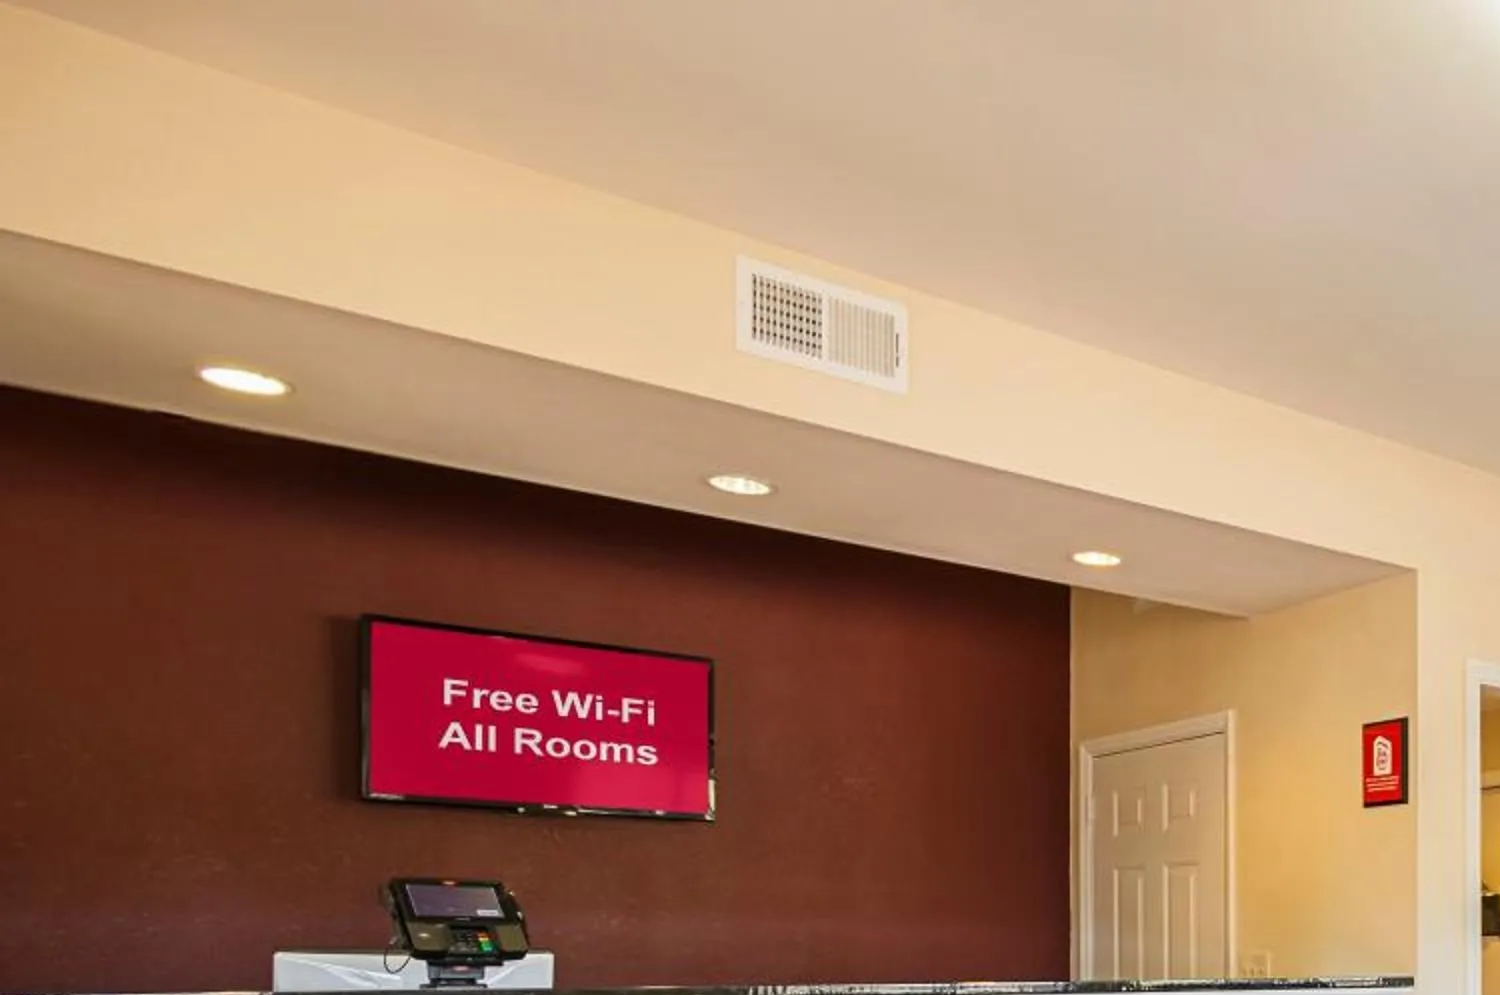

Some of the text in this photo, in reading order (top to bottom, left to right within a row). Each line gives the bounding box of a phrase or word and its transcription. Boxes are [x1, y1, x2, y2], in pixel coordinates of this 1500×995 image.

[443, 678, 656, 726] Free Wi-Fi
[439, 721, 659, 765] All Rooms
